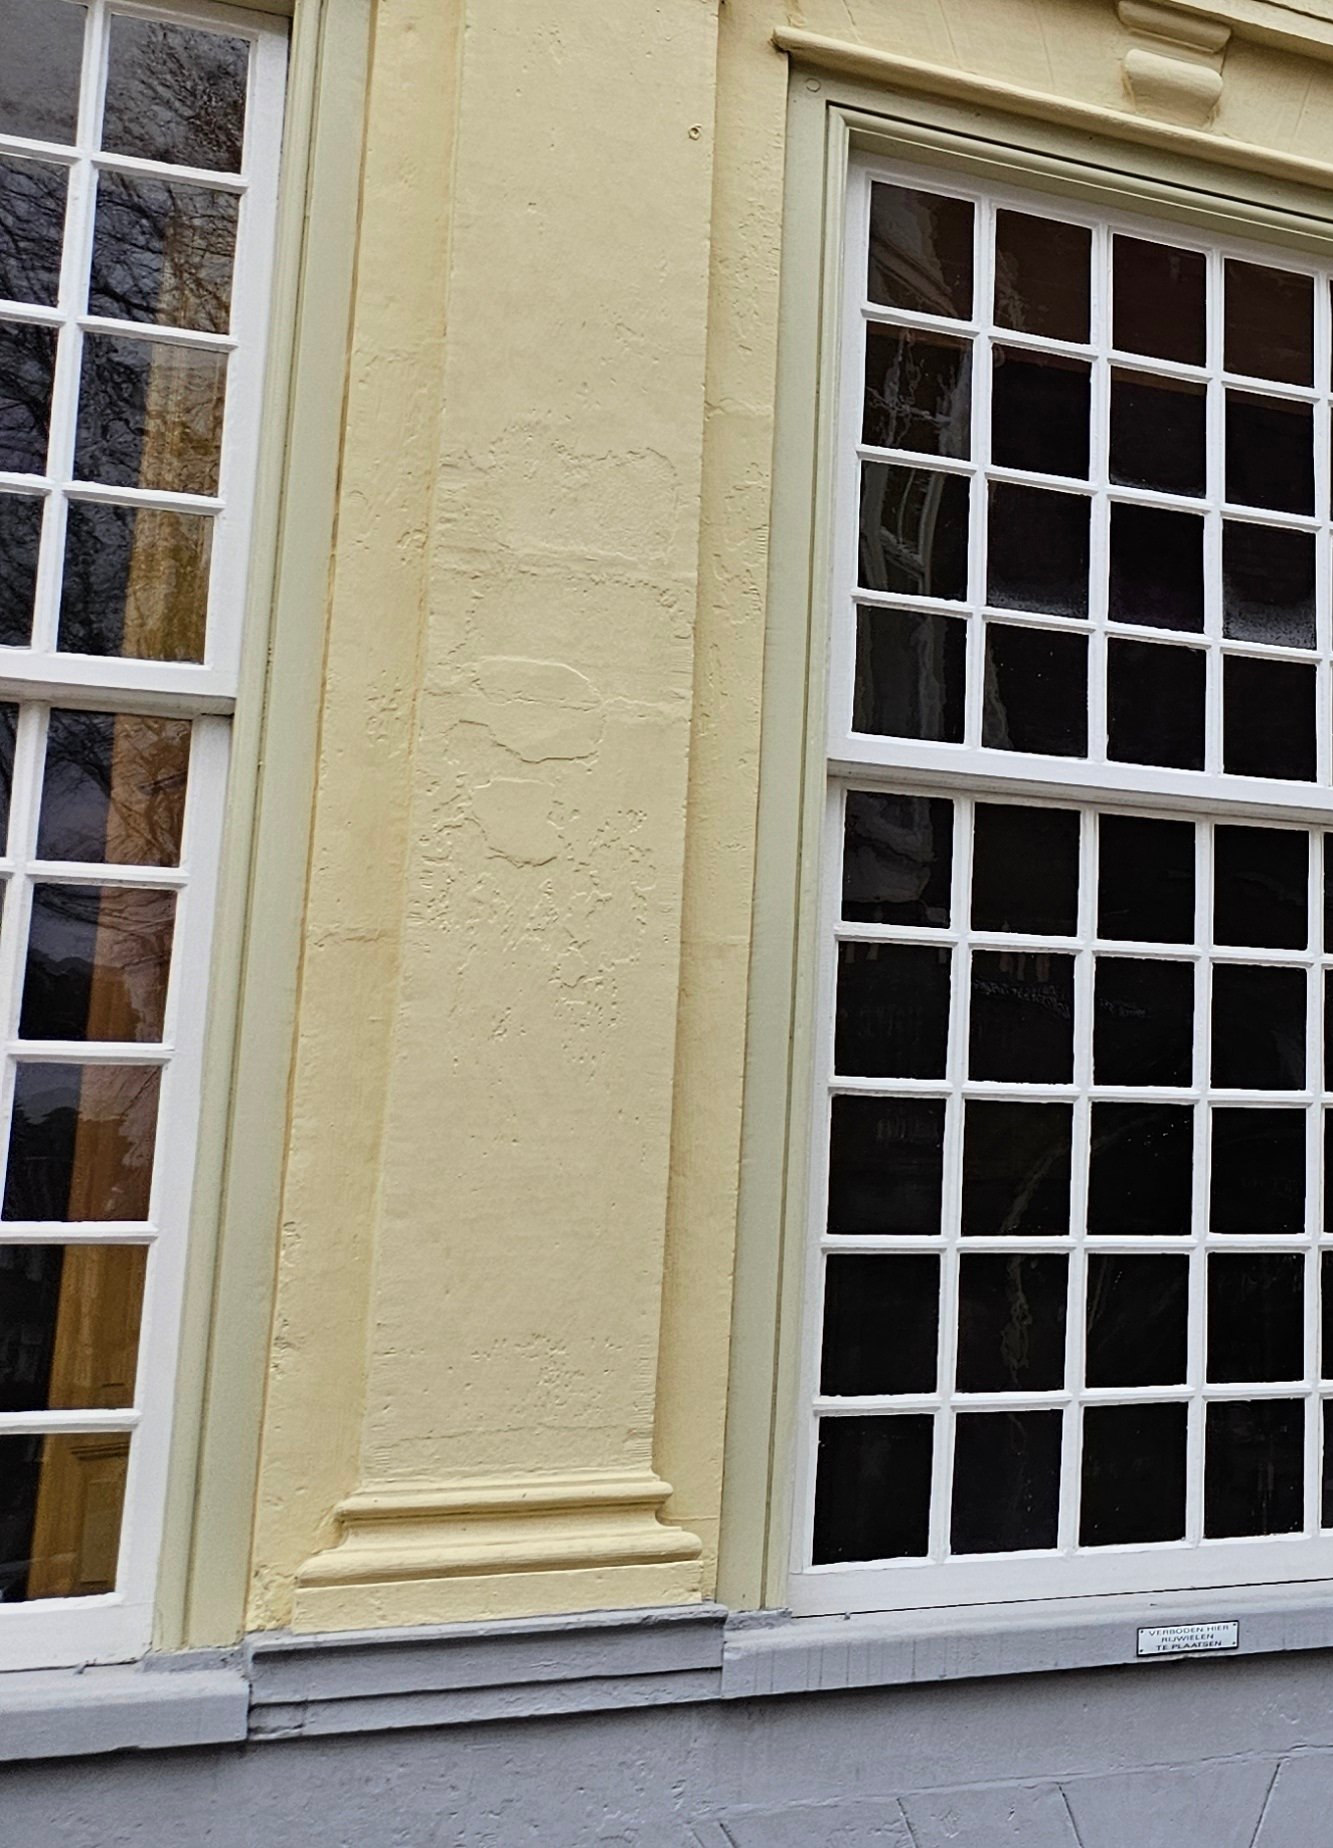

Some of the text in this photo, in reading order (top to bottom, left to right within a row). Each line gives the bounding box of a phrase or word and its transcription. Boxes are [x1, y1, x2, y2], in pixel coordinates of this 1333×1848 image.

[1149, 1628, 1203, 1636] VERBODEN
[1161, 1633, 1214, 1643] RIJWIELEN
[1172, 1640, 1222, 1650] PLAATSEN
